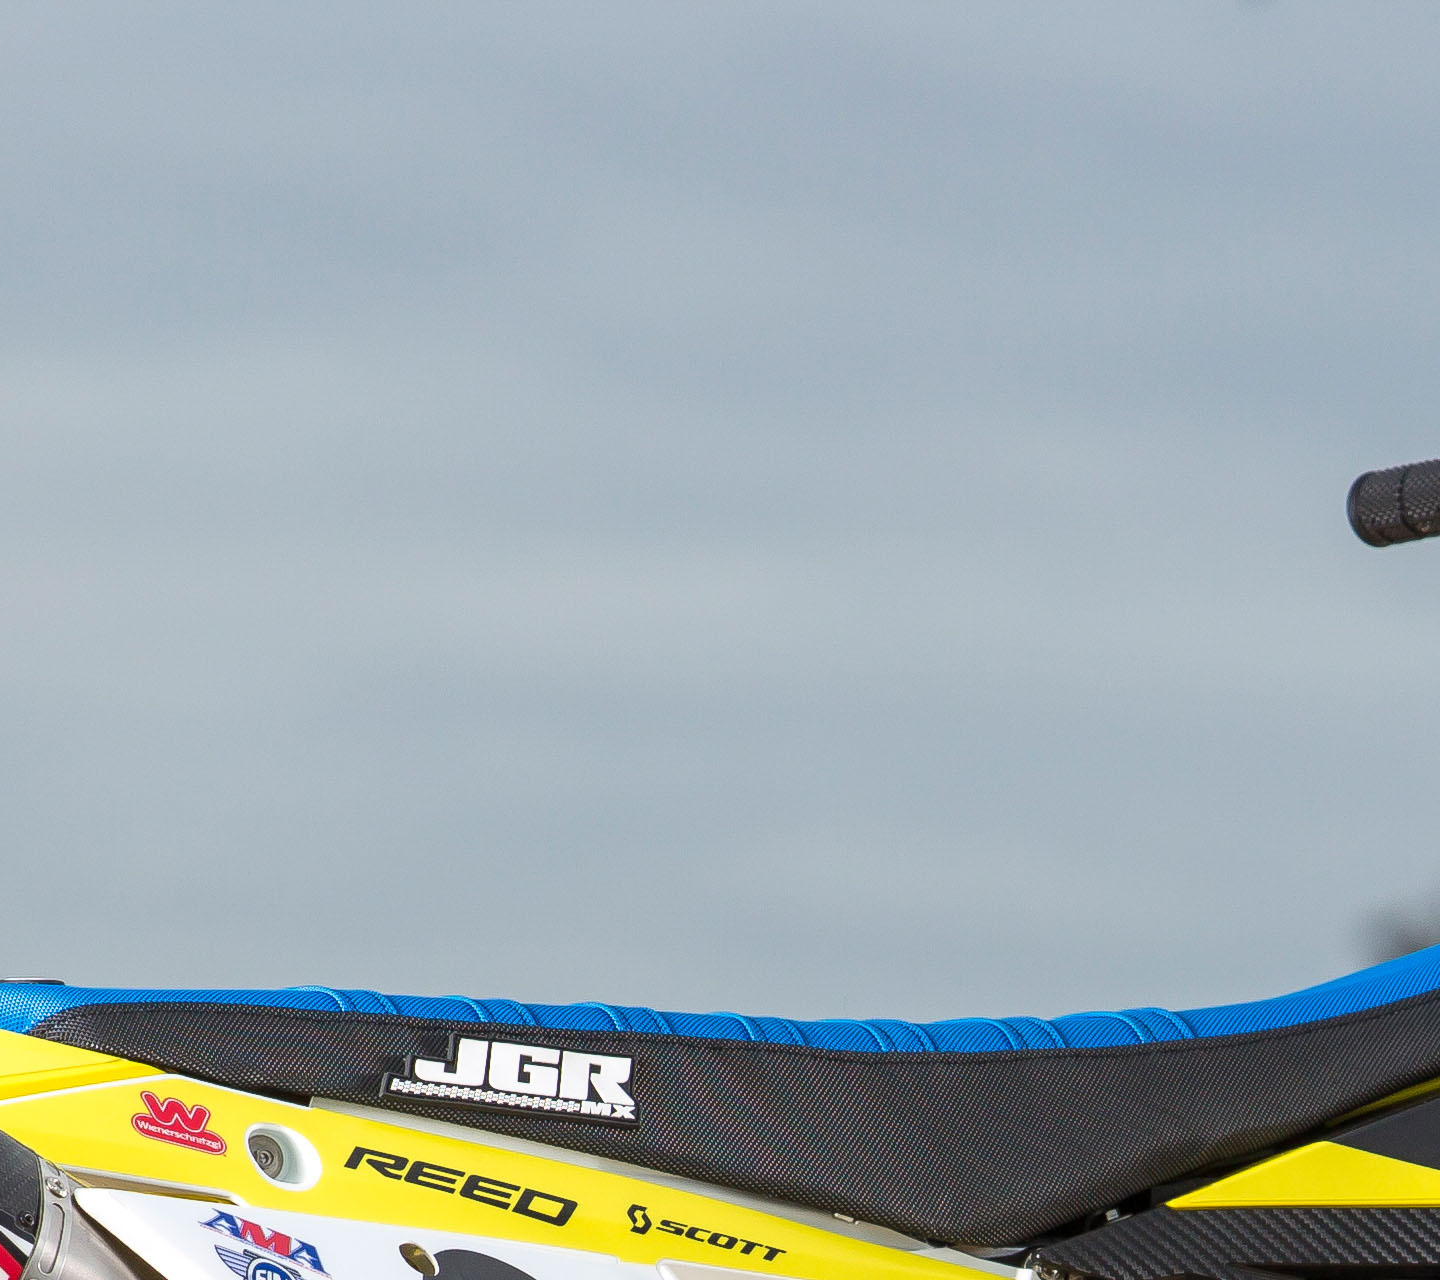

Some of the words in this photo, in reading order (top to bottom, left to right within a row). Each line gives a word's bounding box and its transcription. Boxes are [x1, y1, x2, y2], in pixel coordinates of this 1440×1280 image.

[414, 1037, 635, 1105] JGR
[580, 1100, 636, 1120] MX
[344, 1145, 578, 1227] REED
[198, 1208, 332, 1277] AMA
[654, 1219, 788, 1264] SCOTT
